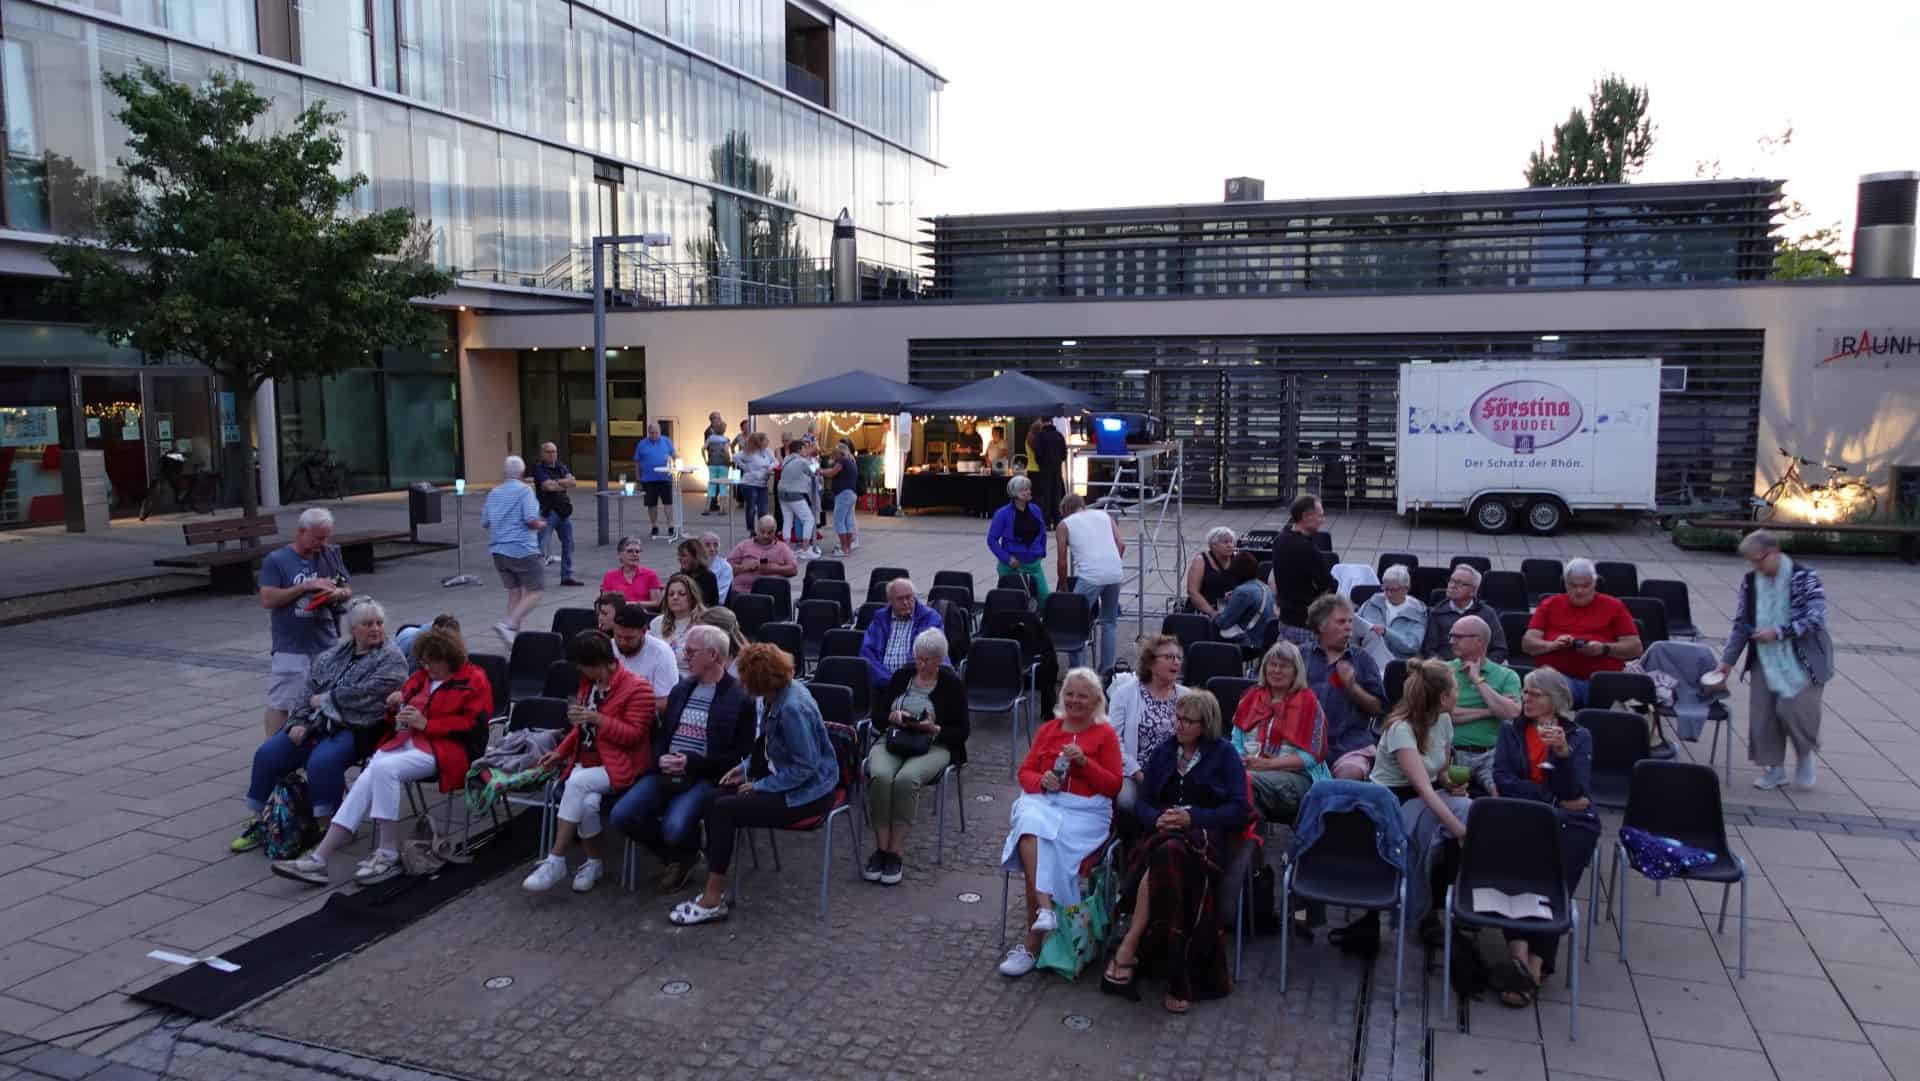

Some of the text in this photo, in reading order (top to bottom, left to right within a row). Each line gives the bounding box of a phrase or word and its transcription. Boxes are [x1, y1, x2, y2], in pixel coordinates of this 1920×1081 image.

[1493, 419, 1556, 431] SPRUDEL
[1464, 457, 1584, 468] Der Schatz der Rhön.
